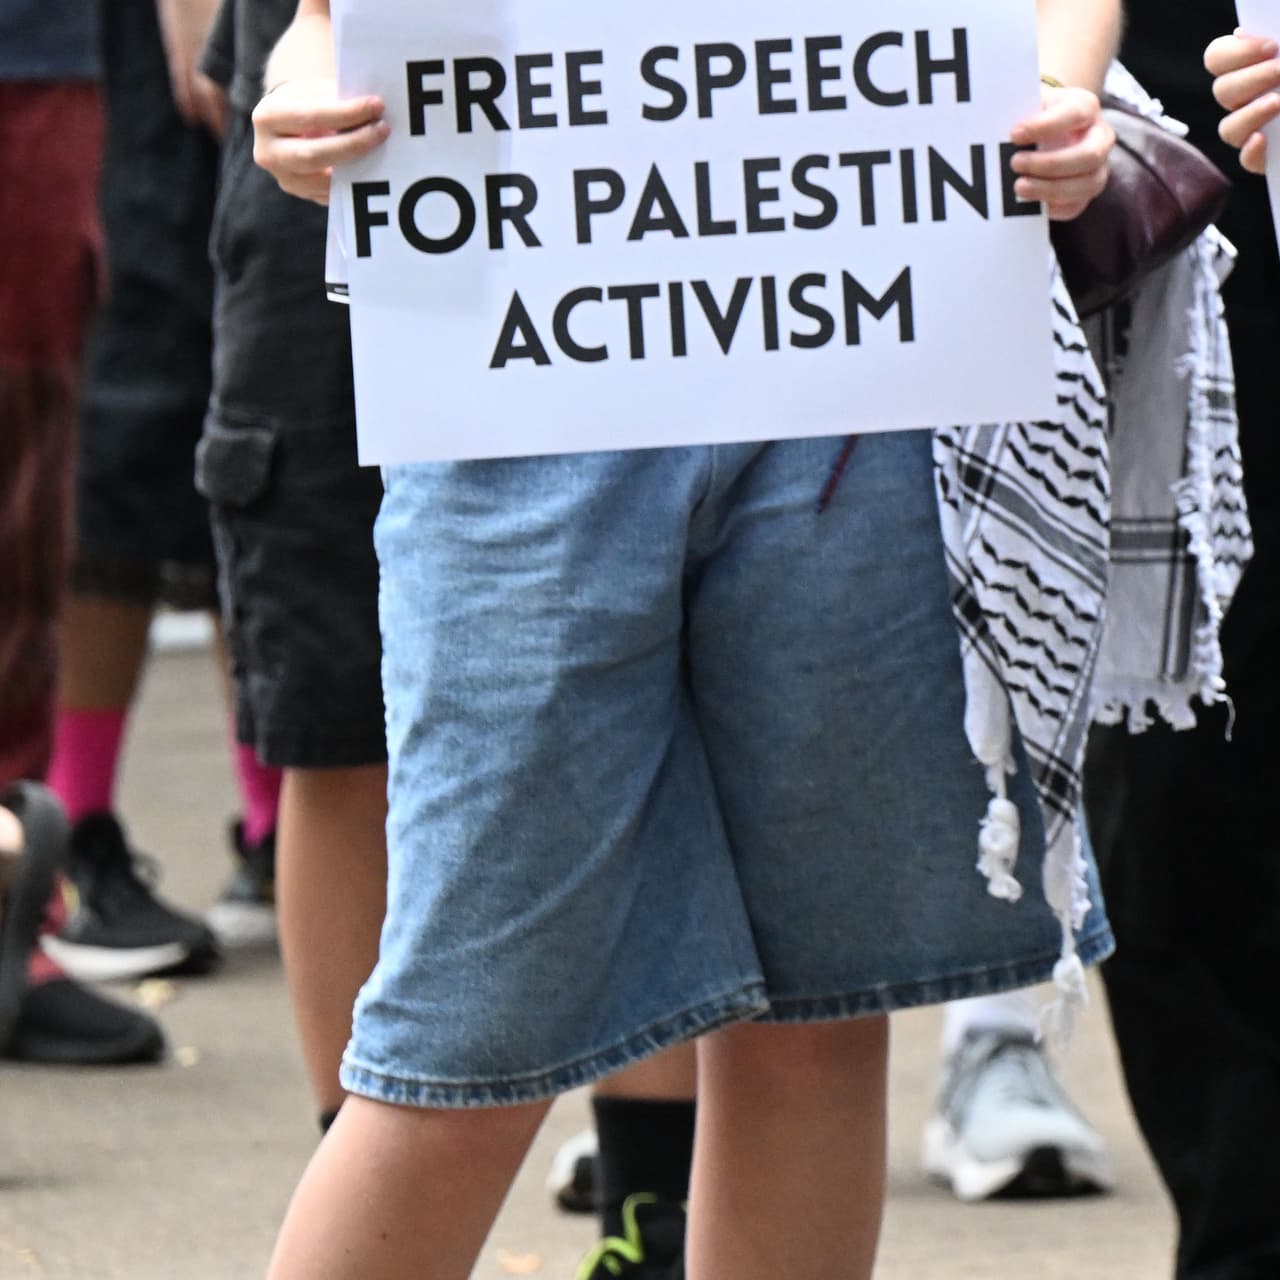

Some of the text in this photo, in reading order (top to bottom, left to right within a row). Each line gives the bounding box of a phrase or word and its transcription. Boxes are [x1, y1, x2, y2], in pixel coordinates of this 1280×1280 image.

[405, 26, 972, 136] FREE SPEECH
[351, 142, 1043, 257] FOR PALESTINE
[489, 265, 916, 369] ACTIVISM
